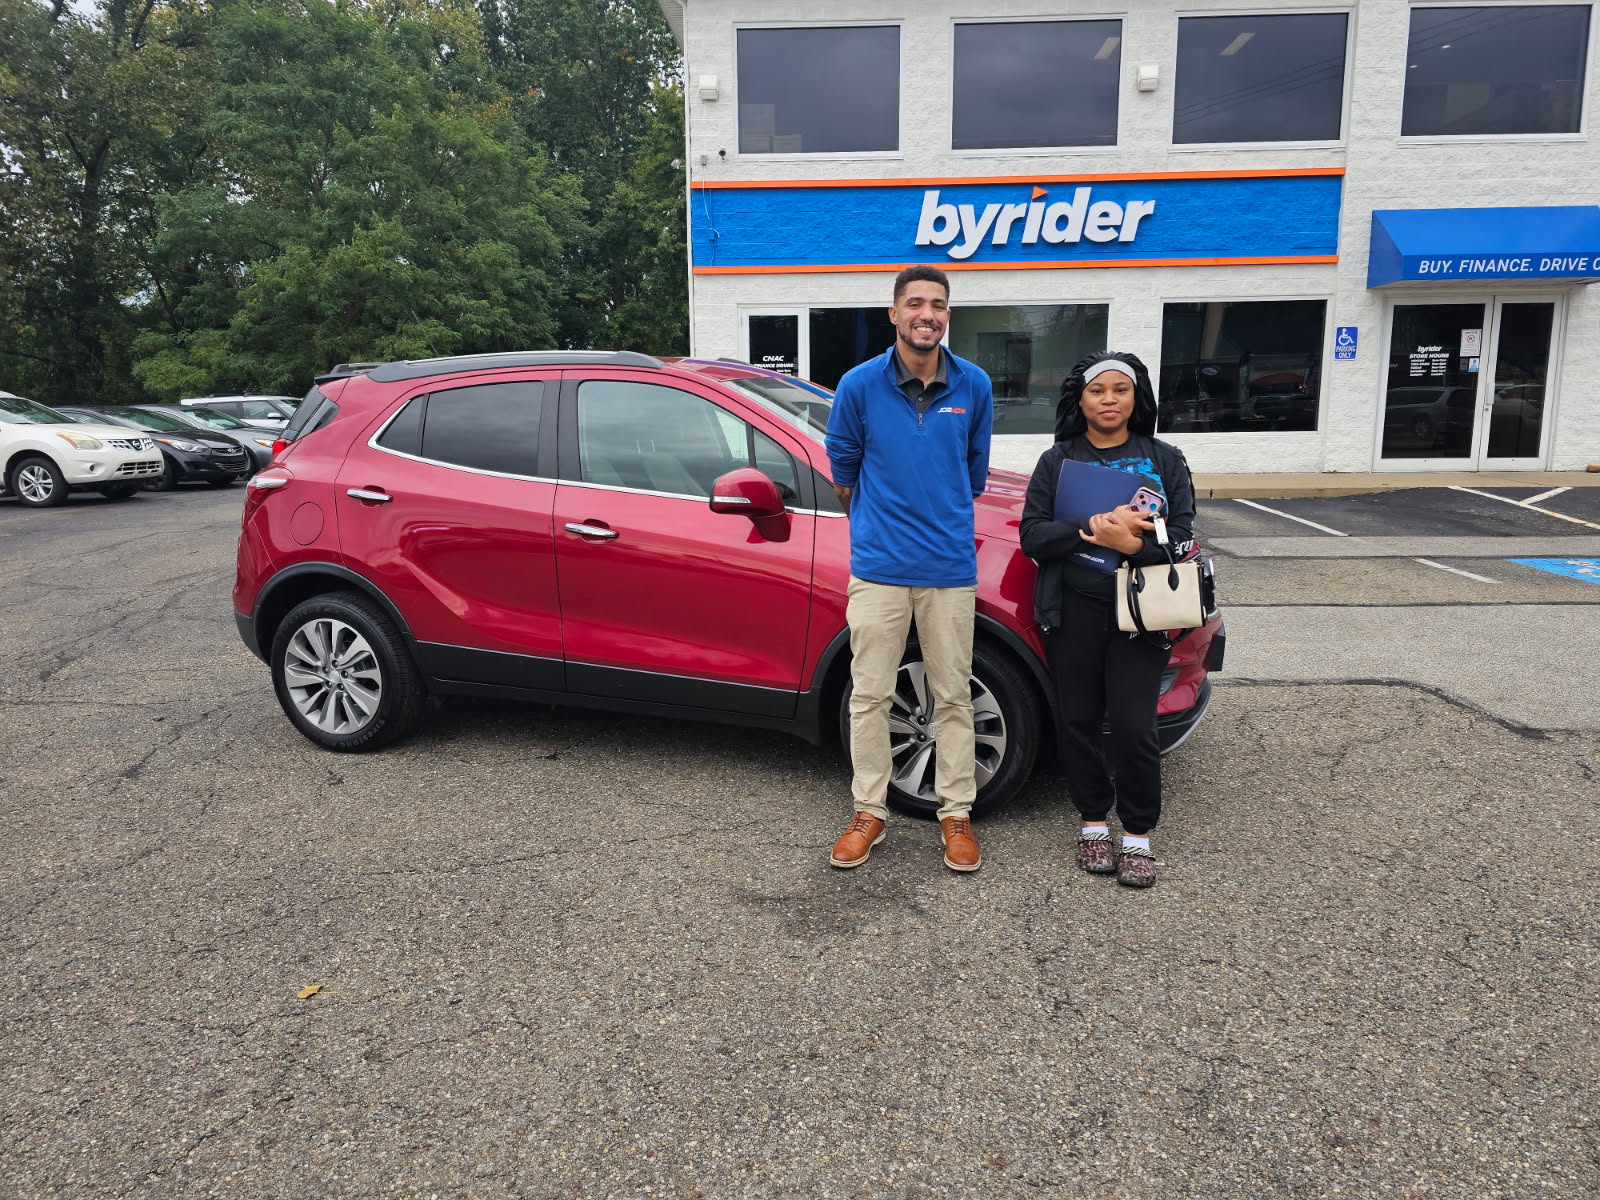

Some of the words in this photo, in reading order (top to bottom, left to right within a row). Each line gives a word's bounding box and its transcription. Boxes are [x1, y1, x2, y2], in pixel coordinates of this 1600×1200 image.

[915, 187, 1156, 259] byrider
[1418, 260, 1453, 274] BUY.
[1458, 258, 1533, 273] FINANCE.
[1539, 257, 1588, 271] DRIVE
[1417, 345, 1442, 353] byrider
